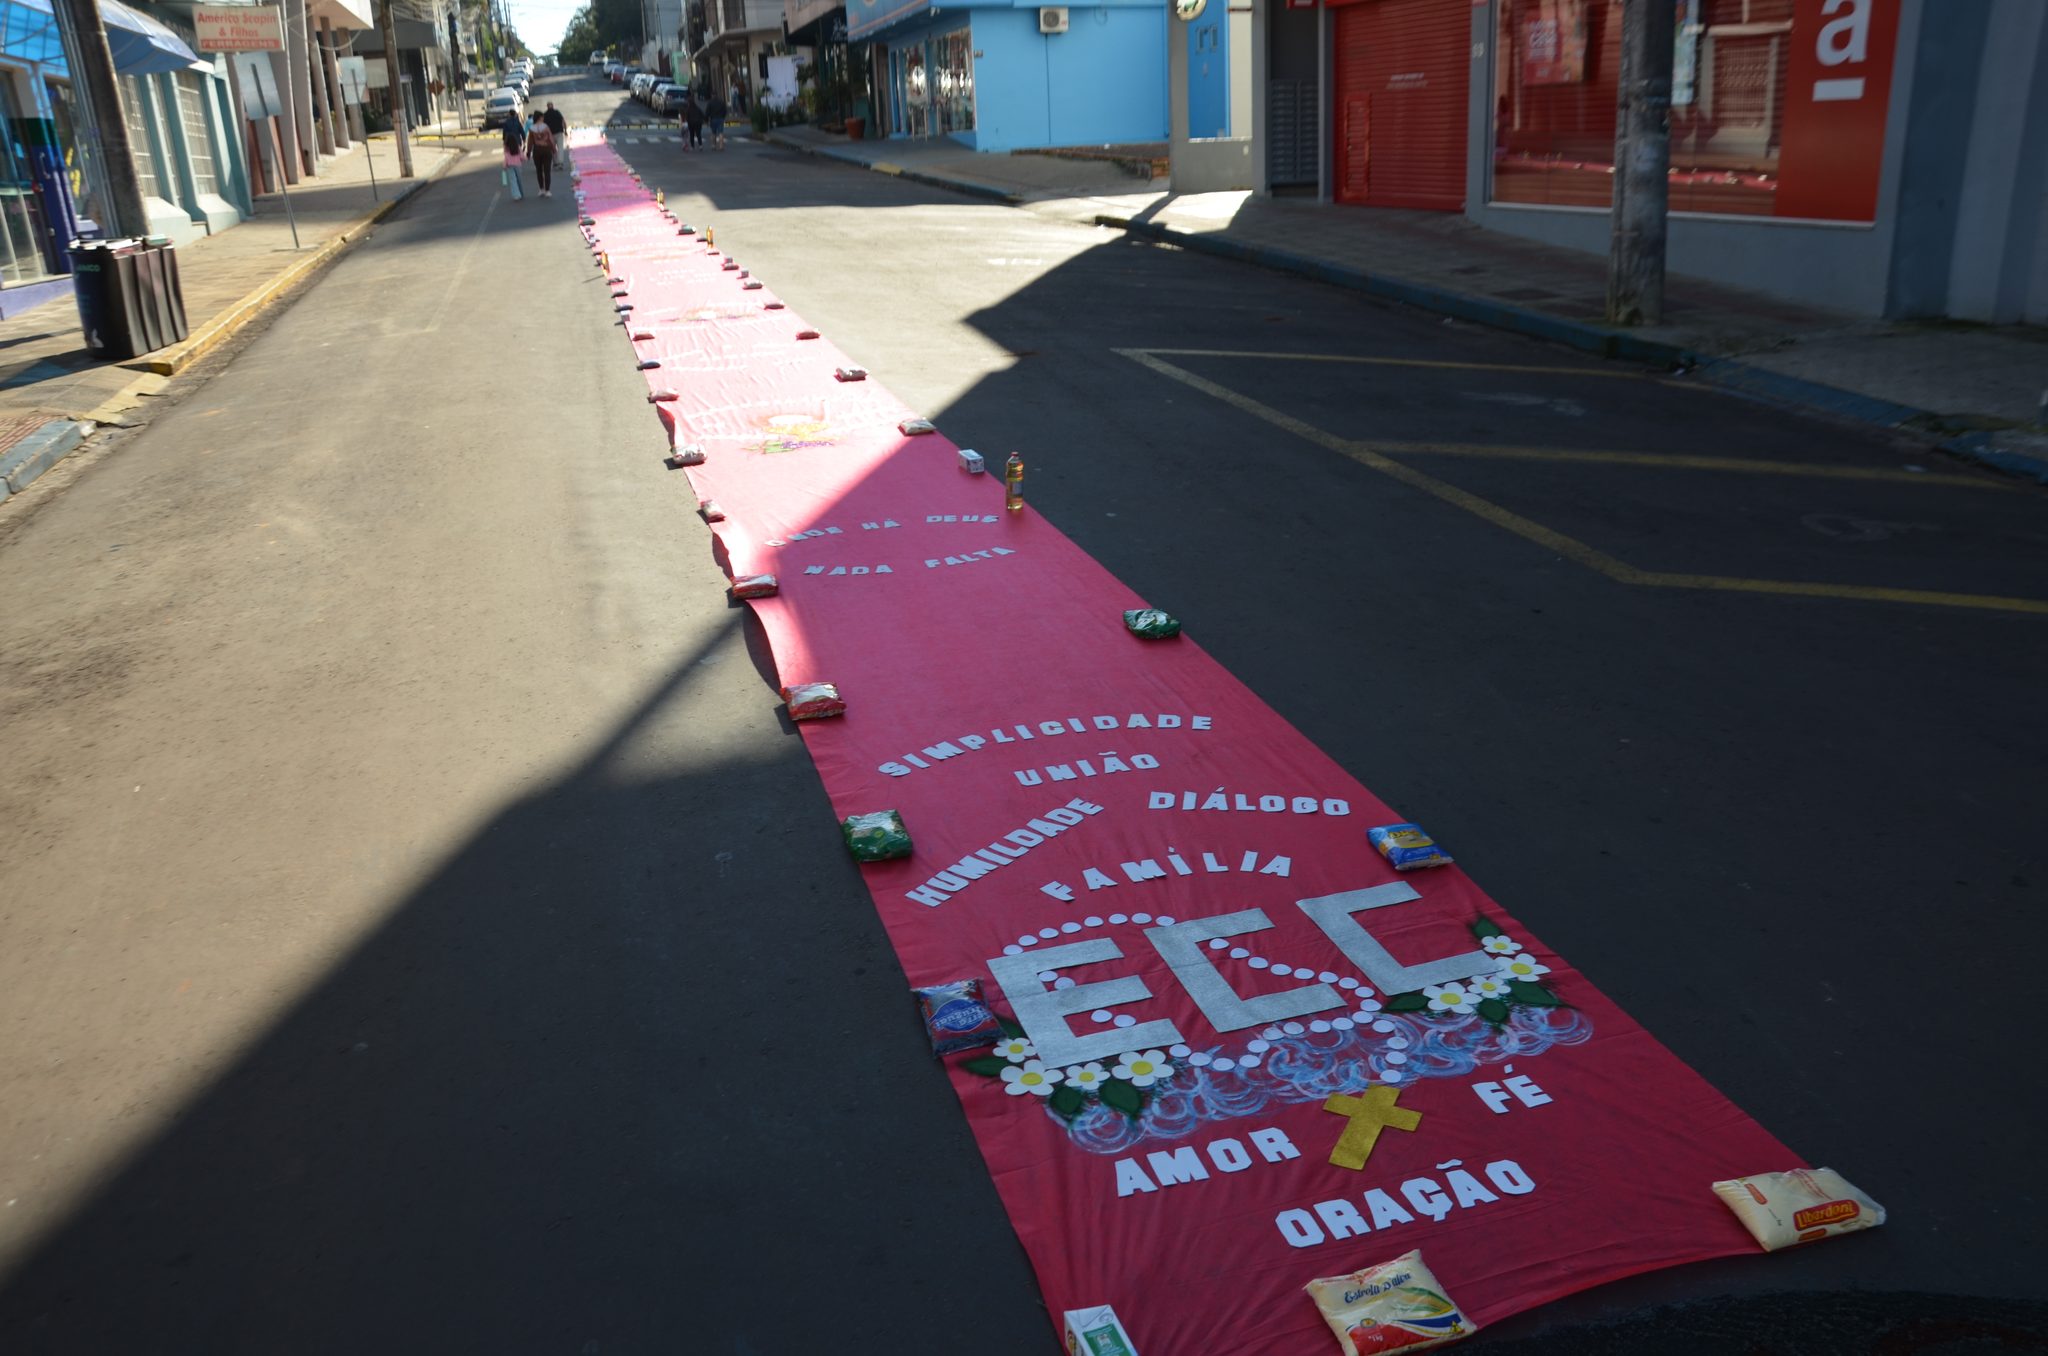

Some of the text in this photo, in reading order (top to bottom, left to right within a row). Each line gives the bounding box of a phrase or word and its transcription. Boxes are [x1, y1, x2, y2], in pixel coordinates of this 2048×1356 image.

[219, 26, 260, 37] & Filhos
[861, 519, 901, 530] HÁ
[926, 515, 998, 523] DEUS
[804, 547, 1016, 575] NADA FALTA
[878, 713, 1212, 777] SIMPLICIDADE
[1014, 751, 1160, 786] UNIÃO
[1148, 787, 1350, 816] DIÁLOGO
[905, 797, 1104, 907] HUMILDADE
[1040, 847, 1291, 901] FAMÍLIA
[986, 880, 1503, 1069] ECC
[1471, 1065, 1554, 1114] FÉ
[1114, 1127, 1301, 1197] AMOR
[1275, 1158, 1536, 1248] ORAÇÃO
[1796, 1201, 1856, 1229] Libardoni
[1344, 1282, 1380, 1304] Estrela
